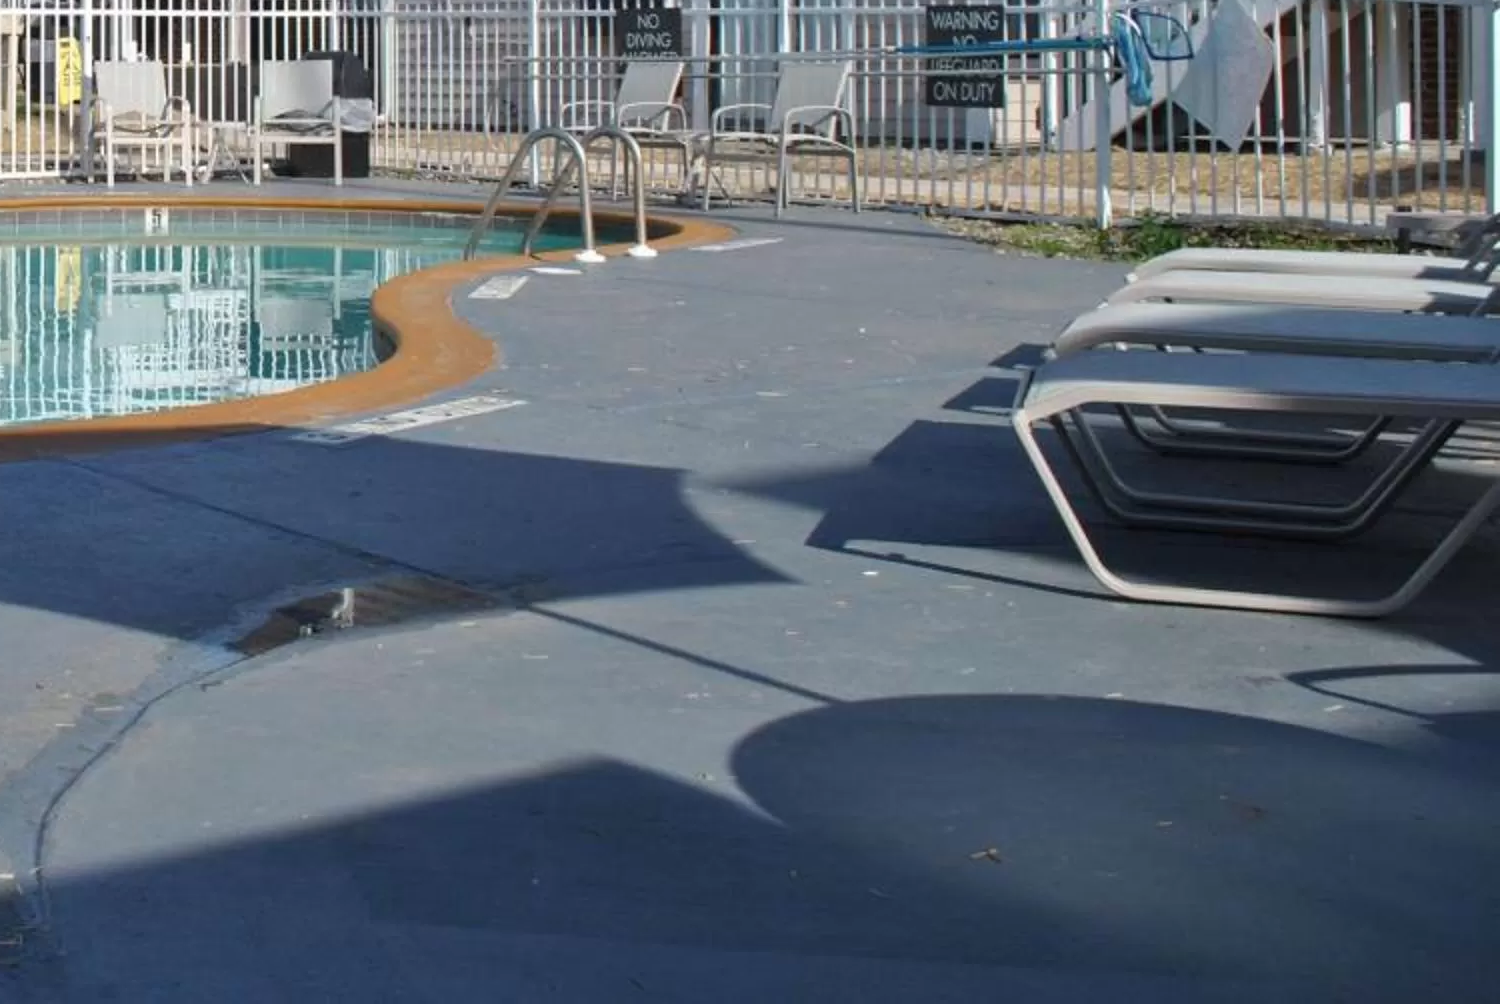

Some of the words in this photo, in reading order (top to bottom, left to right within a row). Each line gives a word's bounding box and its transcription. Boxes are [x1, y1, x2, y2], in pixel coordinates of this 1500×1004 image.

[637, 13, 660, 29] NO
[930, 11, 999, 31] WARNING
[626, 32, 673, 49] DIVING
[933, 81, 957, 100] ON
[961, 82, 996, 101] DUTY
